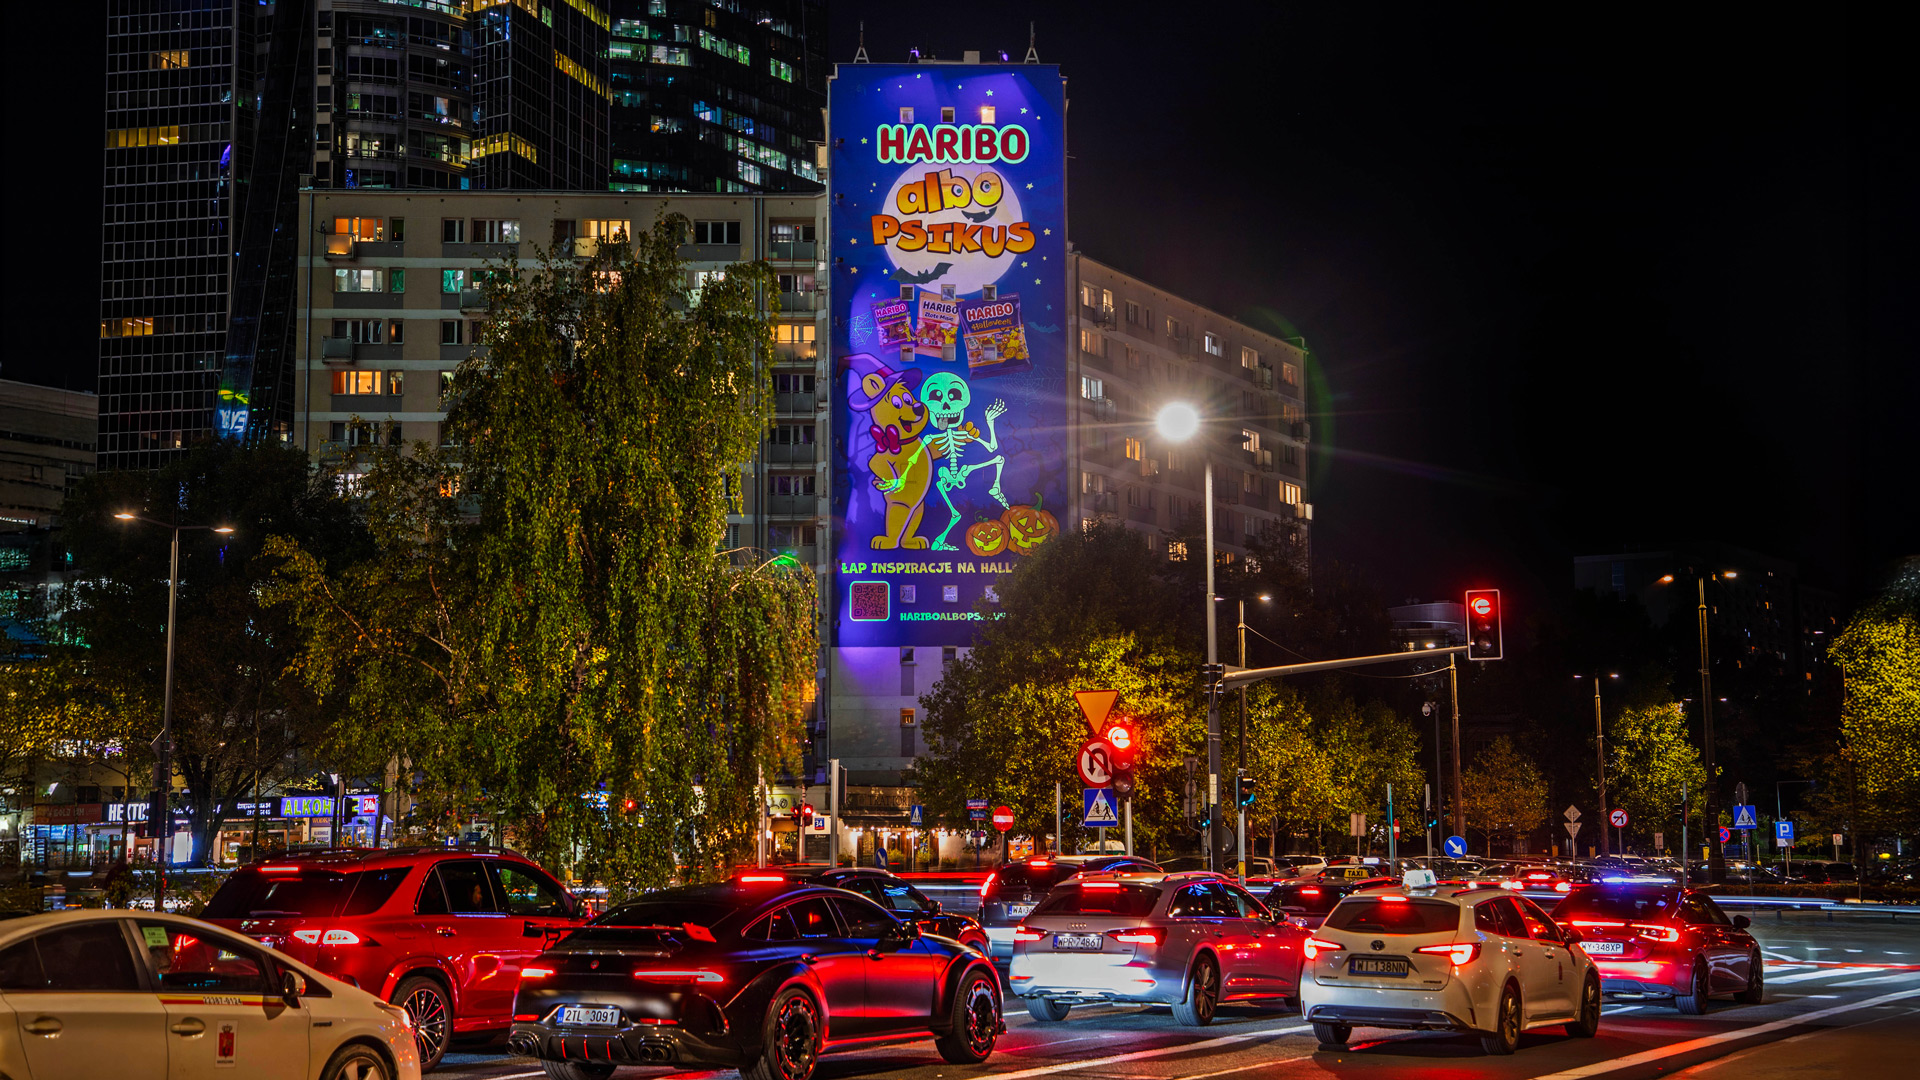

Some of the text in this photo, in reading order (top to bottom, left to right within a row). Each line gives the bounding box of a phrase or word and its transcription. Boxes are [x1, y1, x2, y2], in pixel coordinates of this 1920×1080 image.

[878, 126, 1028, 163] HARIBO
[896, 168, 1003, 215] albo
[871, 214, 1036, 258] PSIKUS
[876, 303, 907, 317] HARIBO
[923, 301, 958, 315] HARIBO
[966, 303, 1014, 321] HARIBO
[841, 562, 867, 574] ŁAP
[871, 562, 952, 574] INSPIRACJE
[957, 562, 976, 574] NA
[1779, 823, 1790, 837] P
[1012, 906, 1023, 914] WA
[1058, 936, 1073, 946] WPR
[1595, 943, 1621, 951] 348XP
[1357, 960, 1406, 973] WI 138NN
[565, 1010, 615, 1023] 2TL 3091
